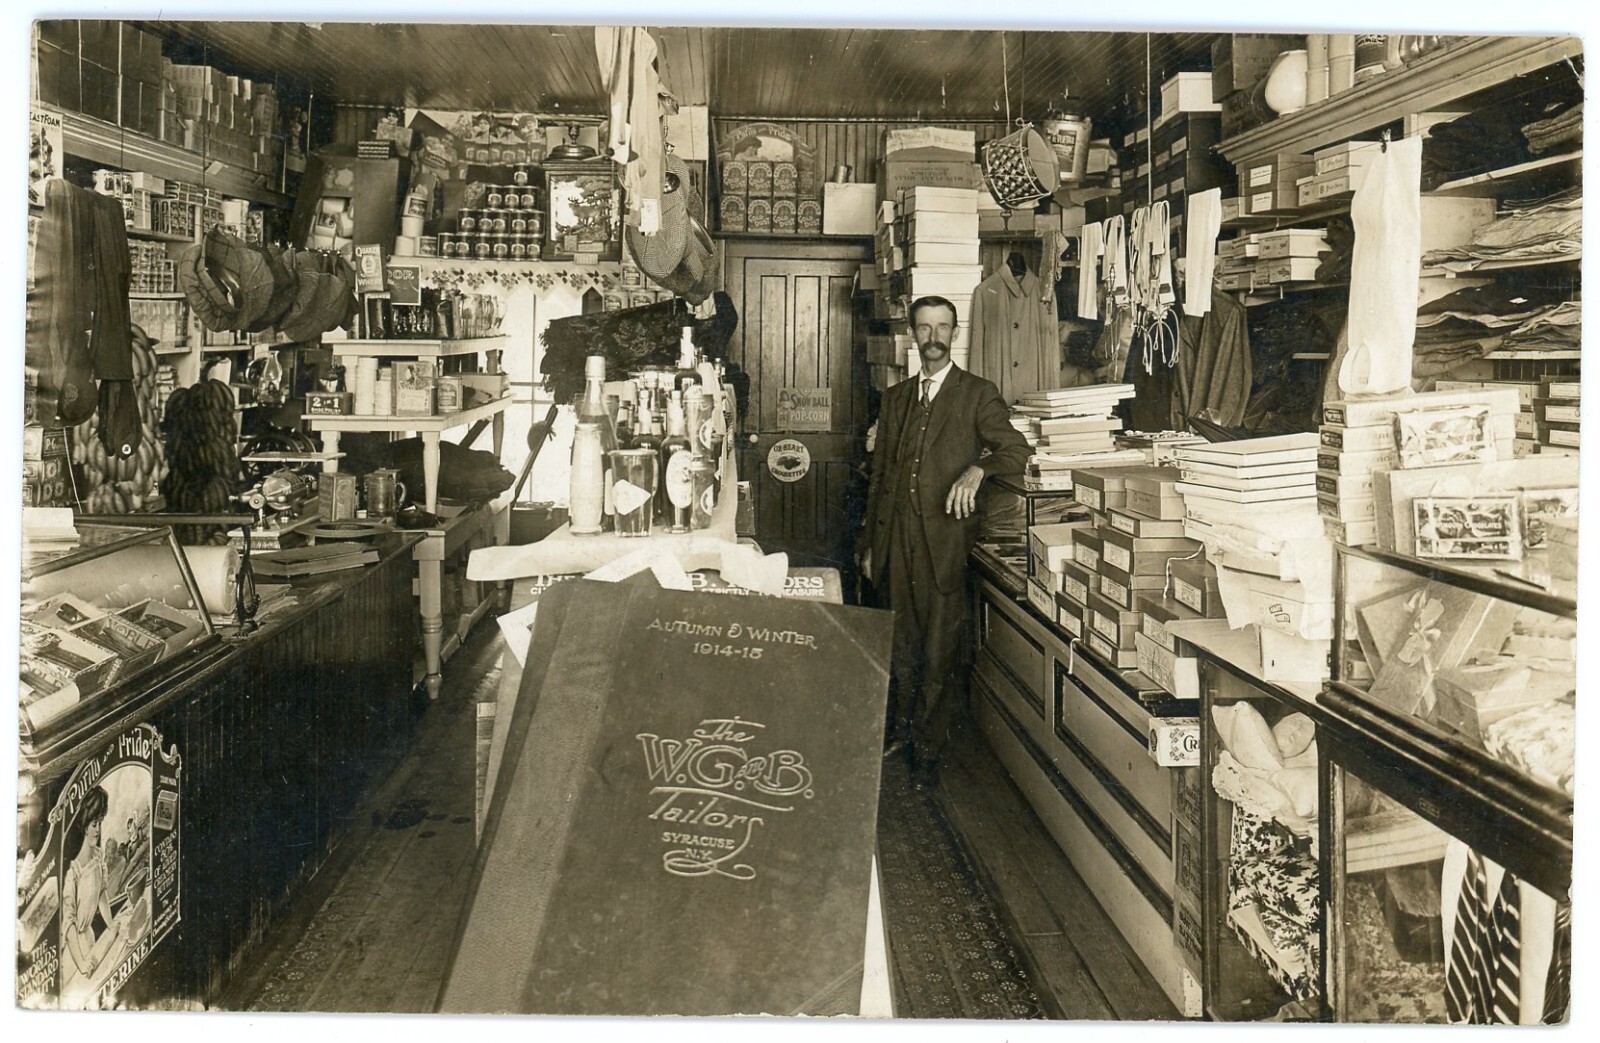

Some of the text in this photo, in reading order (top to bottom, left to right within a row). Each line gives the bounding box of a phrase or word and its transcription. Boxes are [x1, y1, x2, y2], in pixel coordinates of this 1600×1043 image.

[312, 397, 321, 408] 2
[333, 398, 339, 408] 1
[646, 618, 722, 637] AUTUMN
[746, 626, 818, 650] WINTER
[693, 643, 764, 659] 1914-15
[693, 716, 766, 742] The
[1183, 735, 1200, 752] CR
[67, 758, 101, 815] Purity
[118, 728, 151, 760] Pride
[662, 832, 735, 850] SYRACUSE
[32, 939, 49, 962] THE
[20, 945, 58, 985] WORLD'S
[19, 958, 59, 1002] STANDARD
